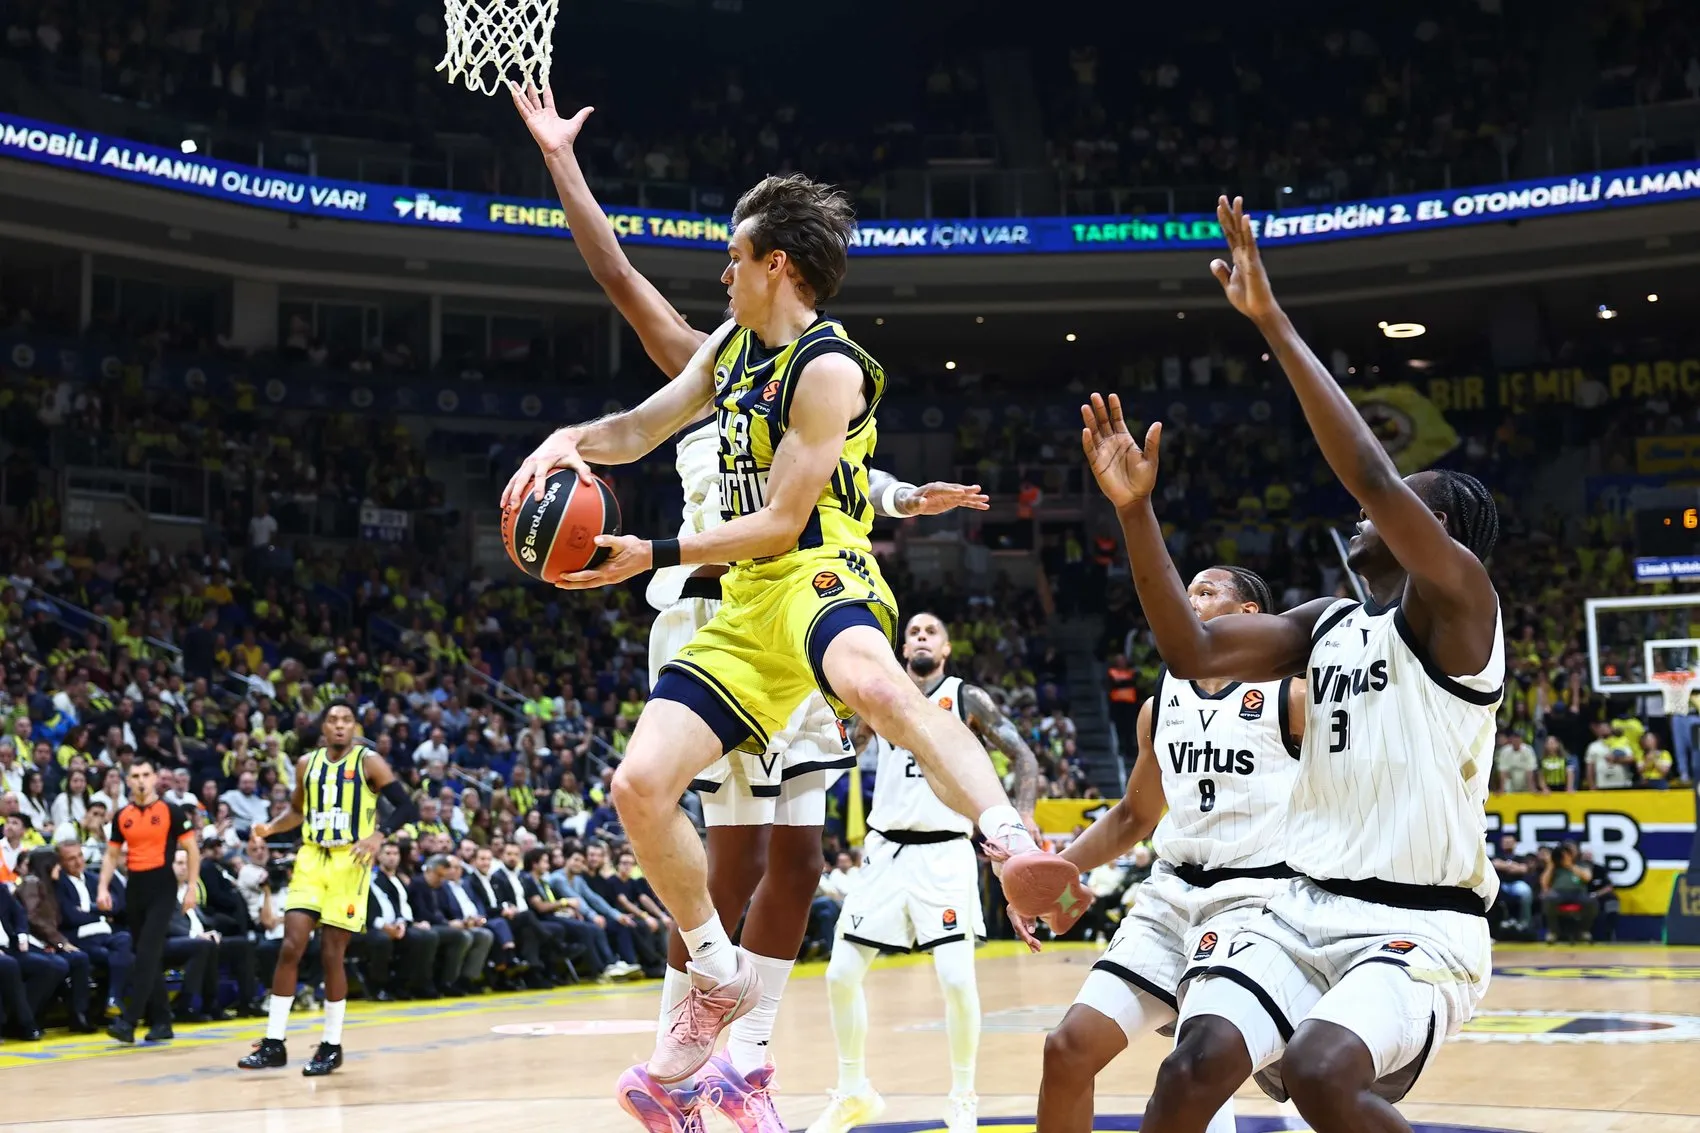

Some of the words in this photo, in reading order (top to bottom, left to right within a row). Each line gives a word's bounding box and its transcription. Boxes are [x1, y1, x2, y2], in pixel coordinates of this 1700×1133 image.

[0, 122, 99, 162] MOBİLİ
[100, 146, 218, 188] ALMANIN
[221, 171, 305, 203] OLURU
[310, 186, 367, 211] VAR!
[489, 203, 646, 238] FENERÇE
[848, 227, 927, 247] ATMAK
[930, 223, 979, 250] İÇİN
[1072, 219, 1159, 242] TARFİN
[1264, 204, 1386, 238] İSTEDİĞİN
[1388, 204, 1412, 225] 2.
[1416, 199, 1449, 221] EL
[1452, 176, 1602, 216] OTOMOBİLİ
[719, 460, 769, 514] arfi
[1683, 508, 1698, 529] 6
[905, 756, 925, 778] 2
[1168, 741, 1255, 776] Virtus
[1199, 779, 1216, 813] 8
[1486, 812, 1645, 889] FB
